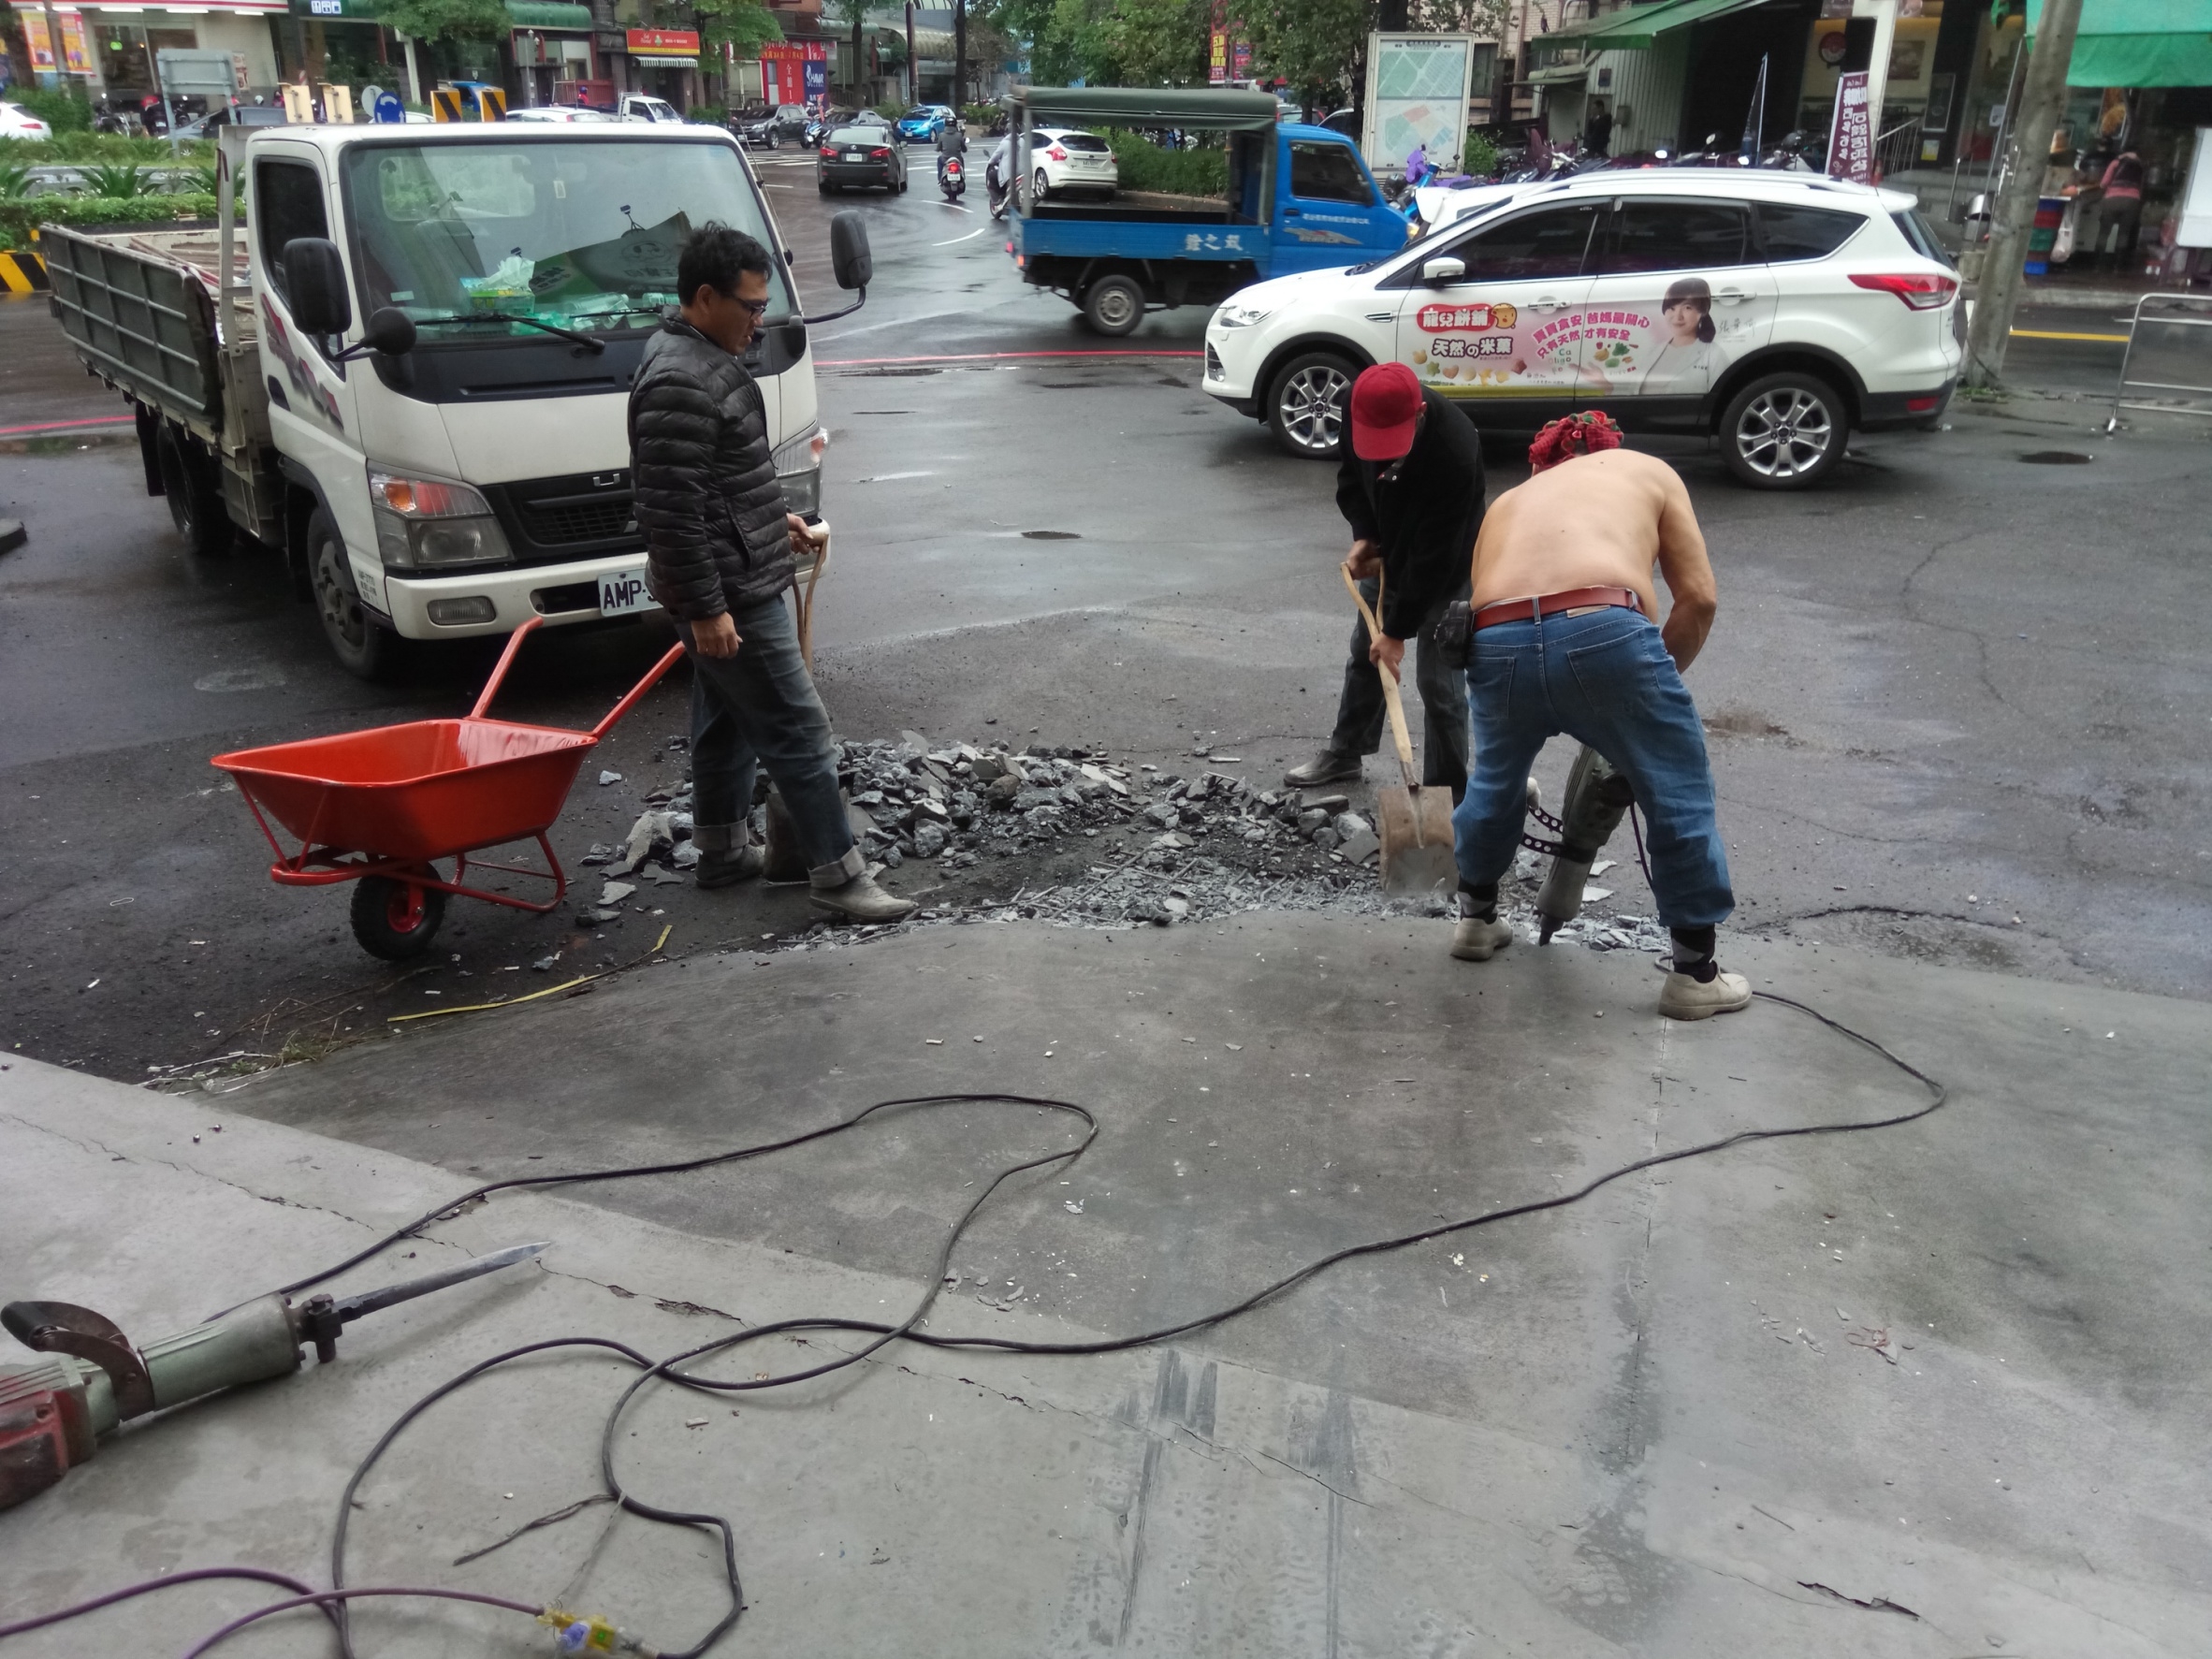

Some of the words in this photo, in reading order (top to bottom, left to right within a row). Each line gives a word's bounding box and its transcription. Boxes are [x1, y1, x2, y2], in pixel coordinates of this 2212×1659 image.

[1536, 330, 1580, 358] 只有天然
[1584, 327, 1630, 341] 才有安全
